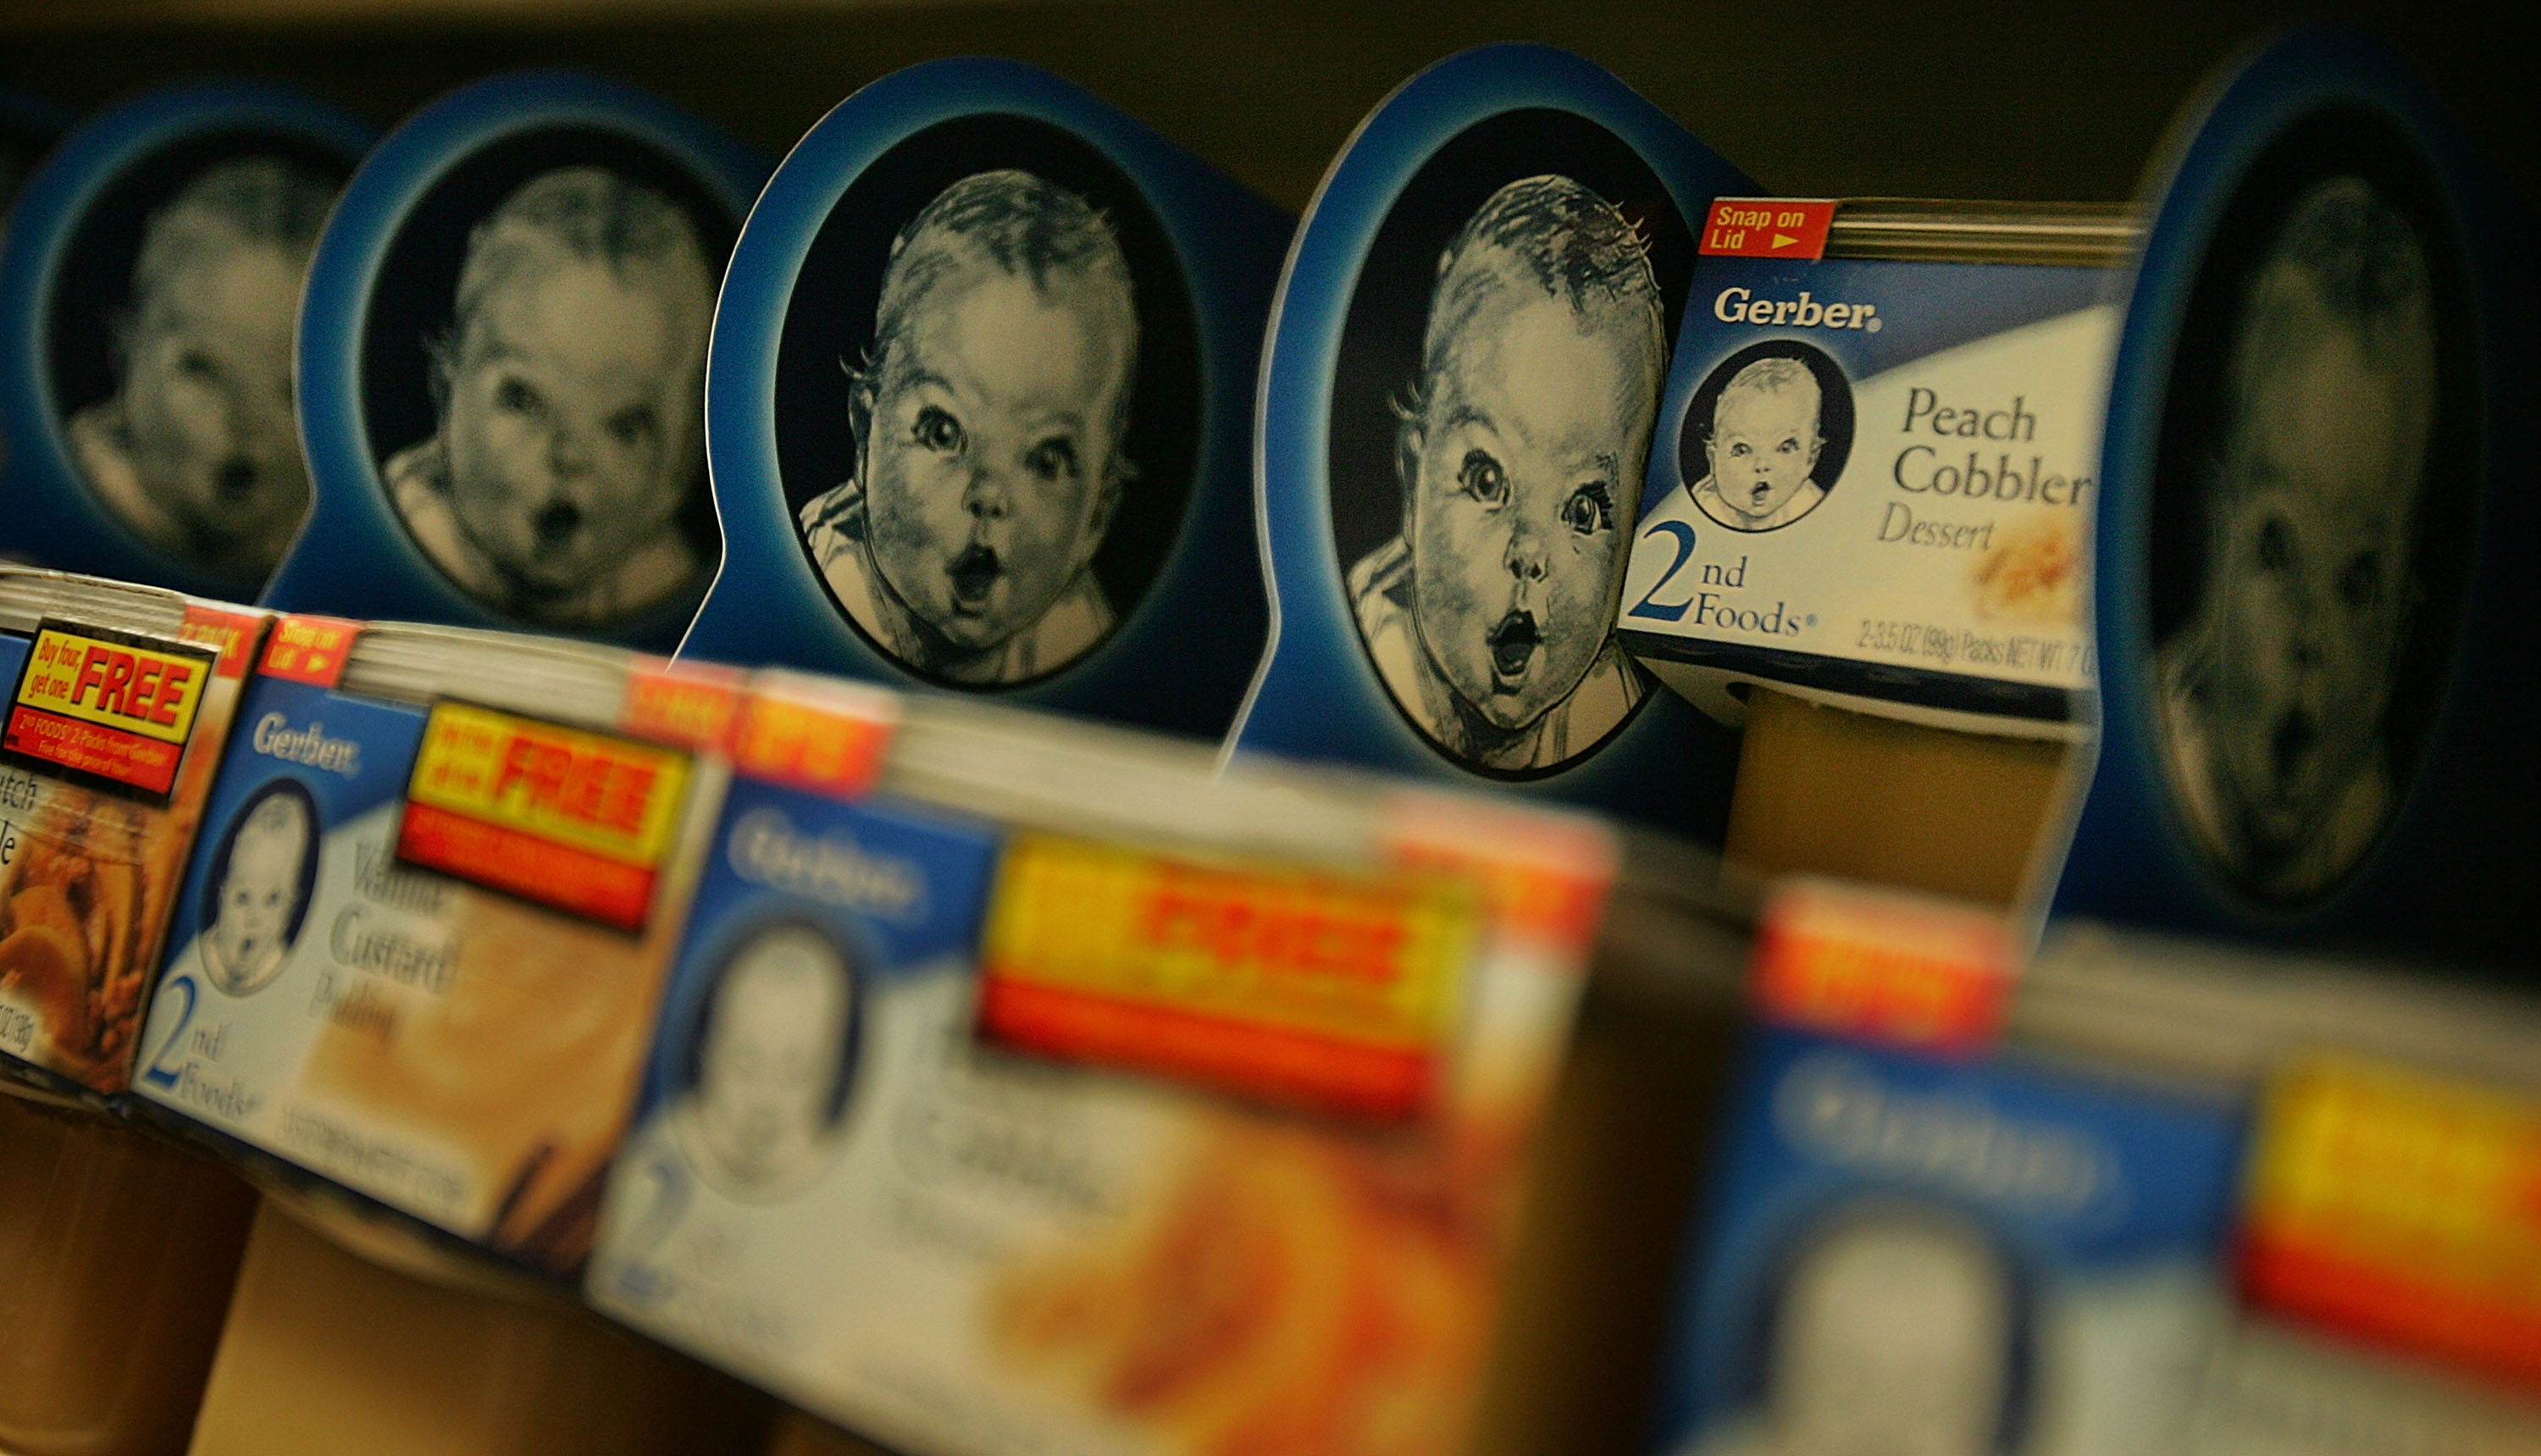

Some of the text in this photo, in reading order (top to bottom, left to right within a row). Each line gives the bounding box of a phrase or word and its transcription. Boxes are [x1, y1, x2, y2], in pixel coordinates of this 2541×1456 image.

[1709, 229, 1746, 250] Lid
[1717, 206, 1805, 231] Snap on
[1713, 286, 1876, 329] Gerber
[1902, 386, 2036, 441] Peach
[1893, 445, 2092, 506] Cobbler
[1877, 501, 1996, 551] Dessert
[29, 673, 69, 700] get one
[38, 637, 58, 669] Buy
[70, 645, 191, 728] FREE
[253, 711, 360, 775] Gerber
